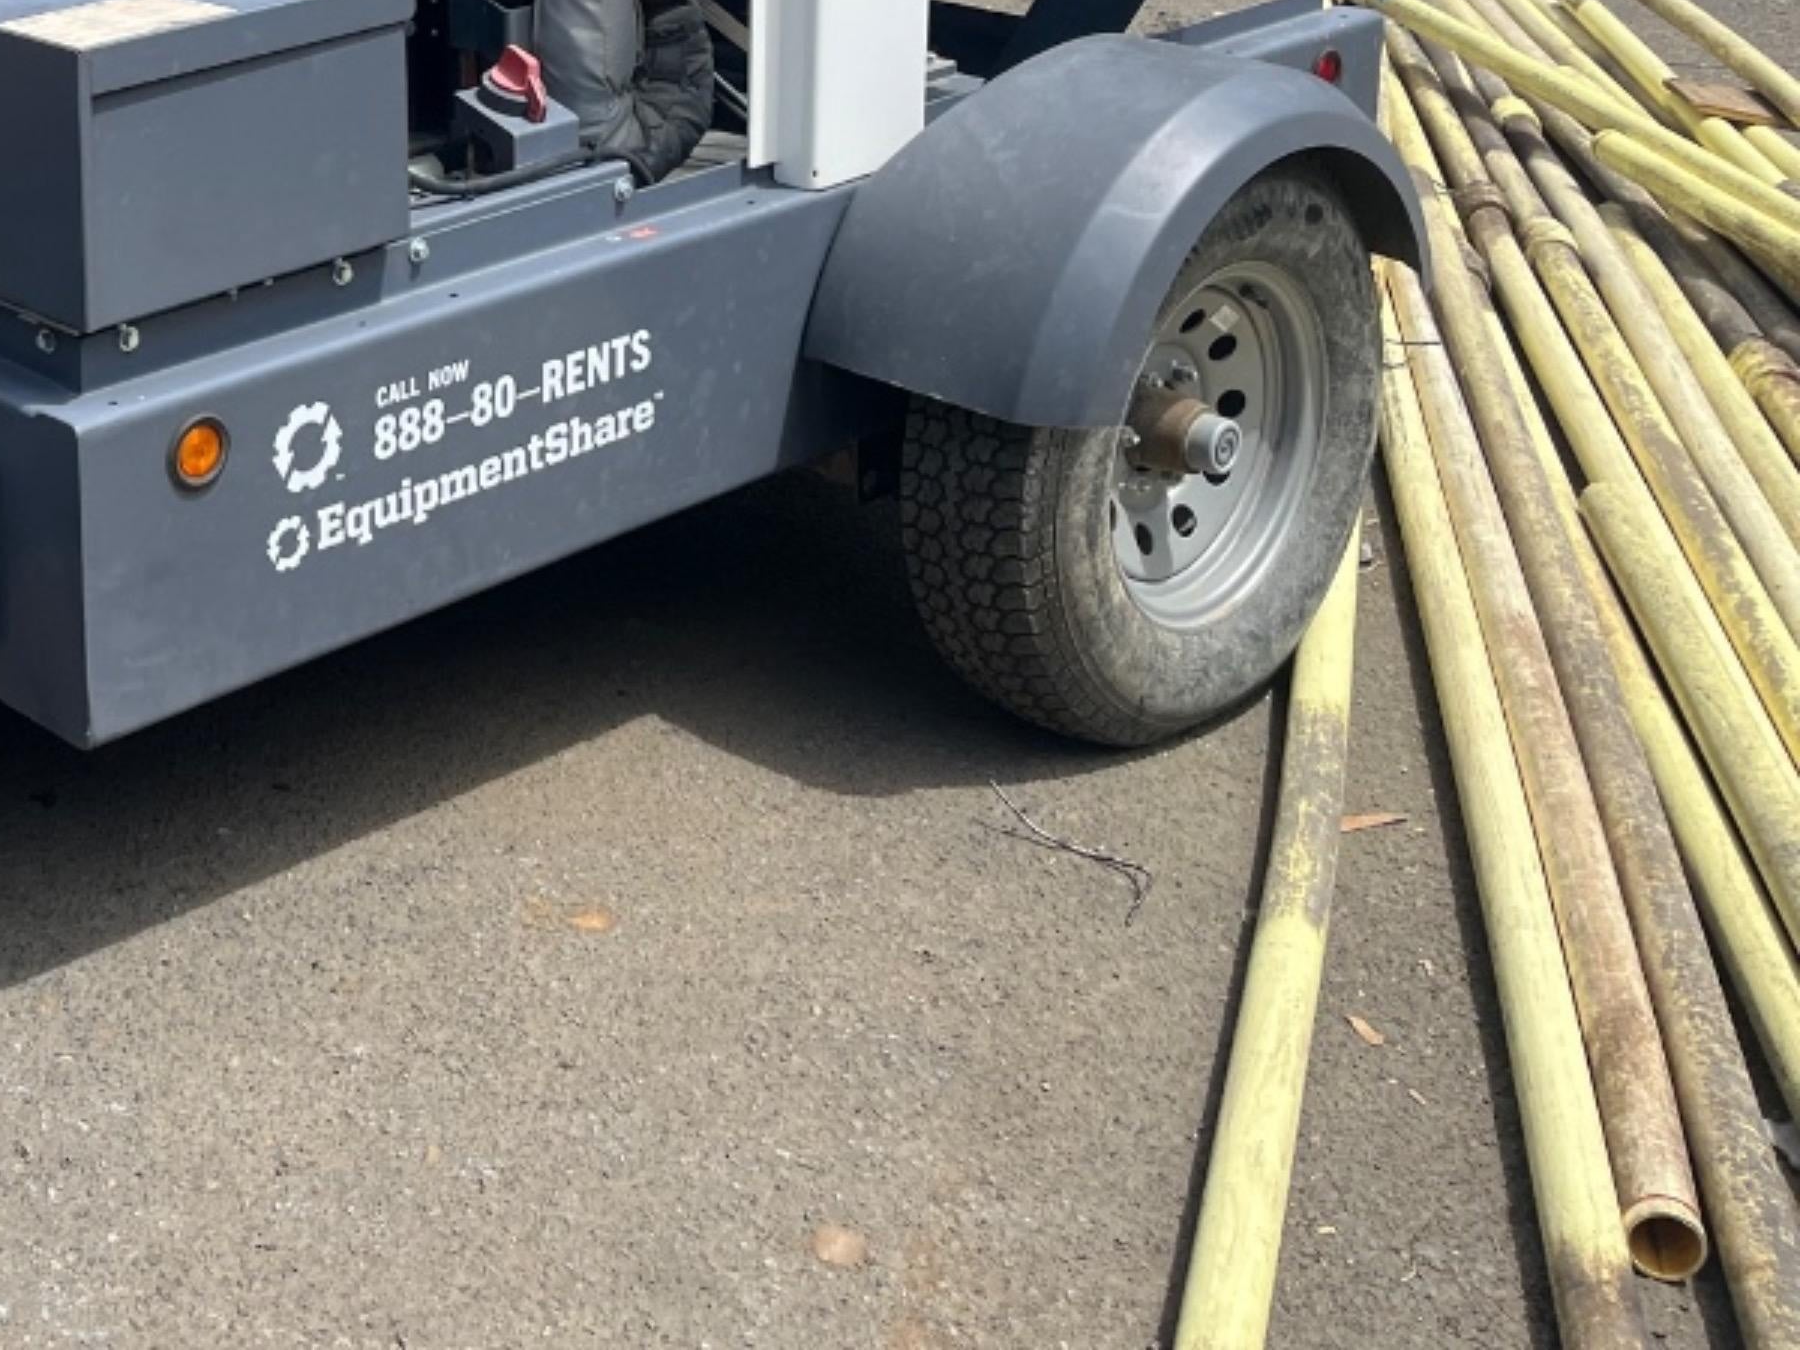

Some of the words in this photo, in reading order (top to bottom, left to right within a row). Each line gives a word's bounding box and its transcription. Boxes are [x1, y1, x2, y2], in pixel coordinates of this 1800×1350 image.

[373, 329, 652, 461] 888-80-RENTS
[375, 377, 421, 409] CALL
[428, 359, 470, 391] NOW
[316, 398, 656, 551] EquipmentShare
